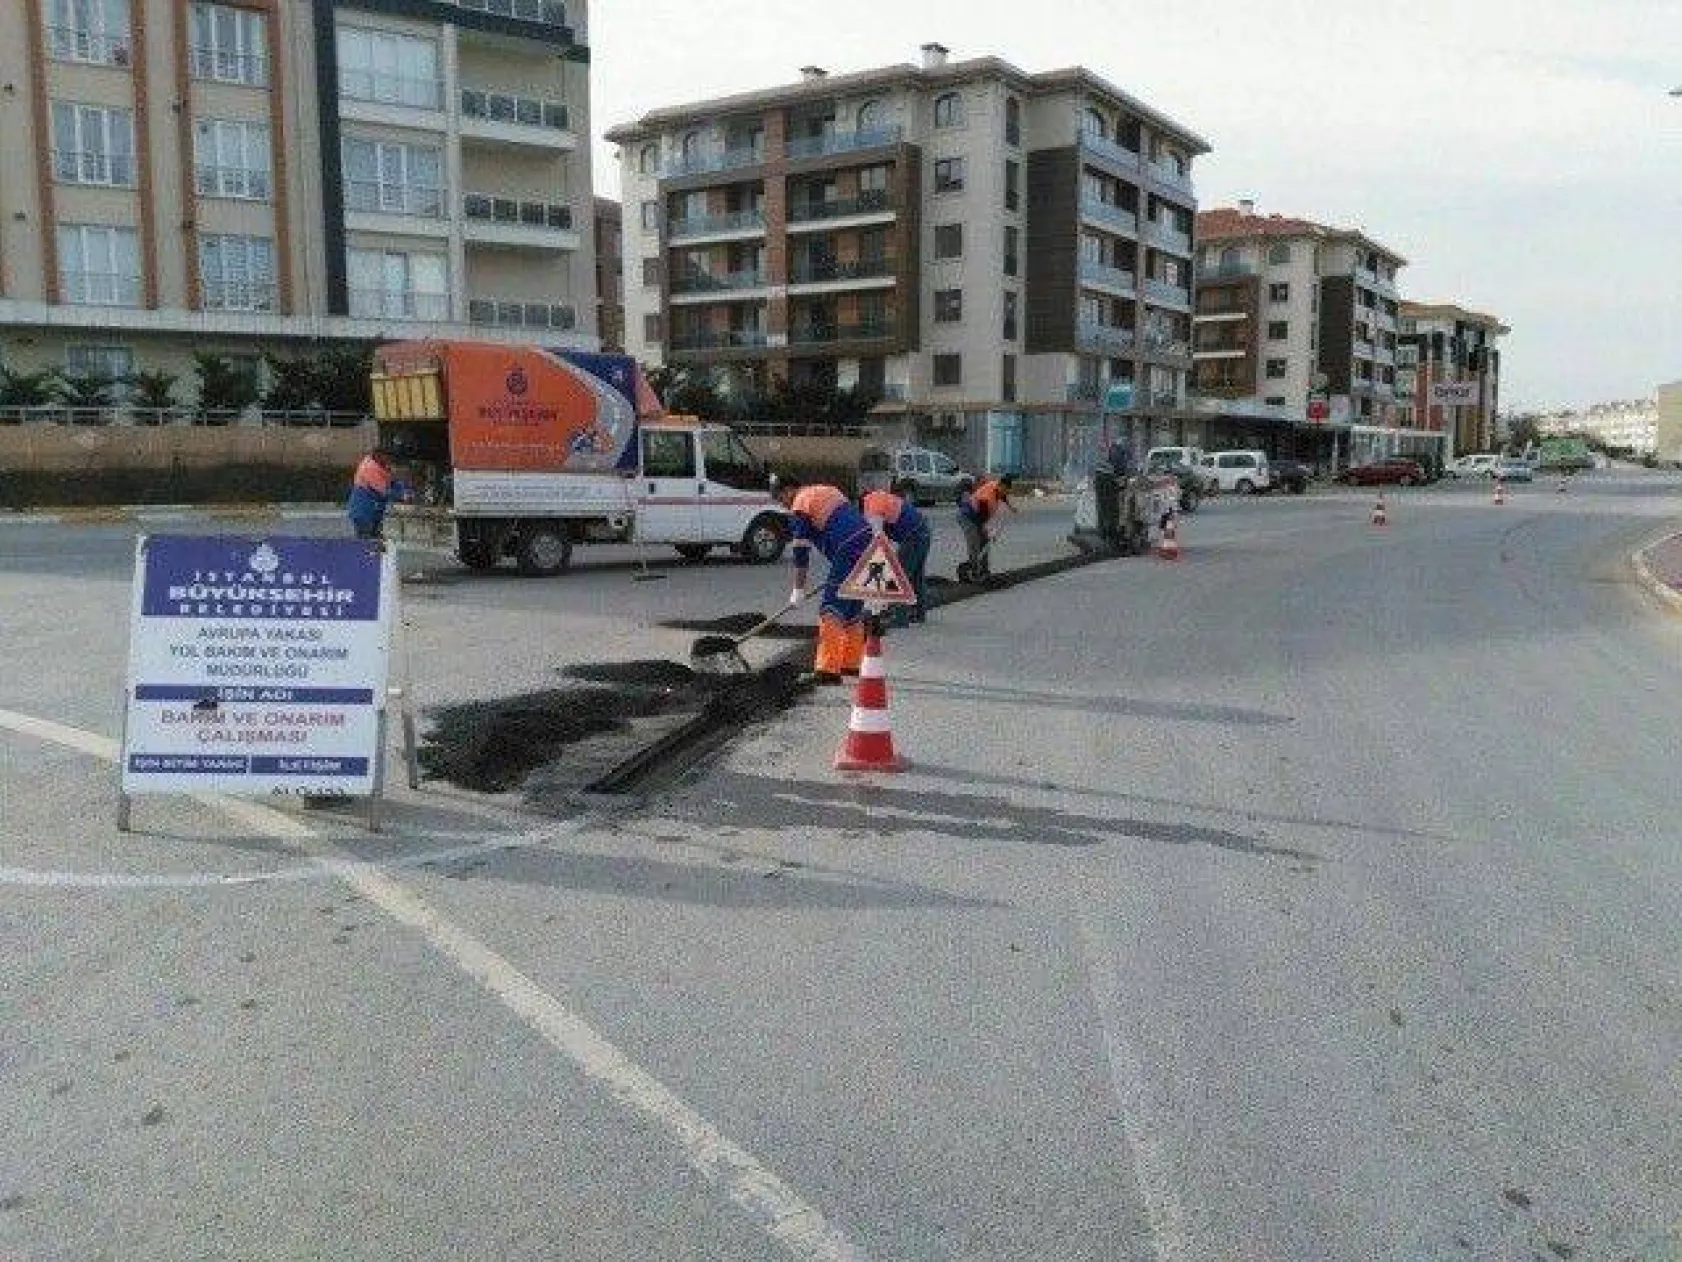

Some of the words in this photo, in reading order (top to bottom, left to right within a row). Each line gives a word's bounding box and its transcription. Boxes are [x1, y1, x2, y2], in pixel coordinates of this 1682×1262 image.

[198, 627, 260, 640] AVRUPA
[266, 628, 323, 640] YAKASI
[170, 643, 198, 656] YOL
[261, 646, 280, 658] VE
[233, 711, 258, 724] VE
